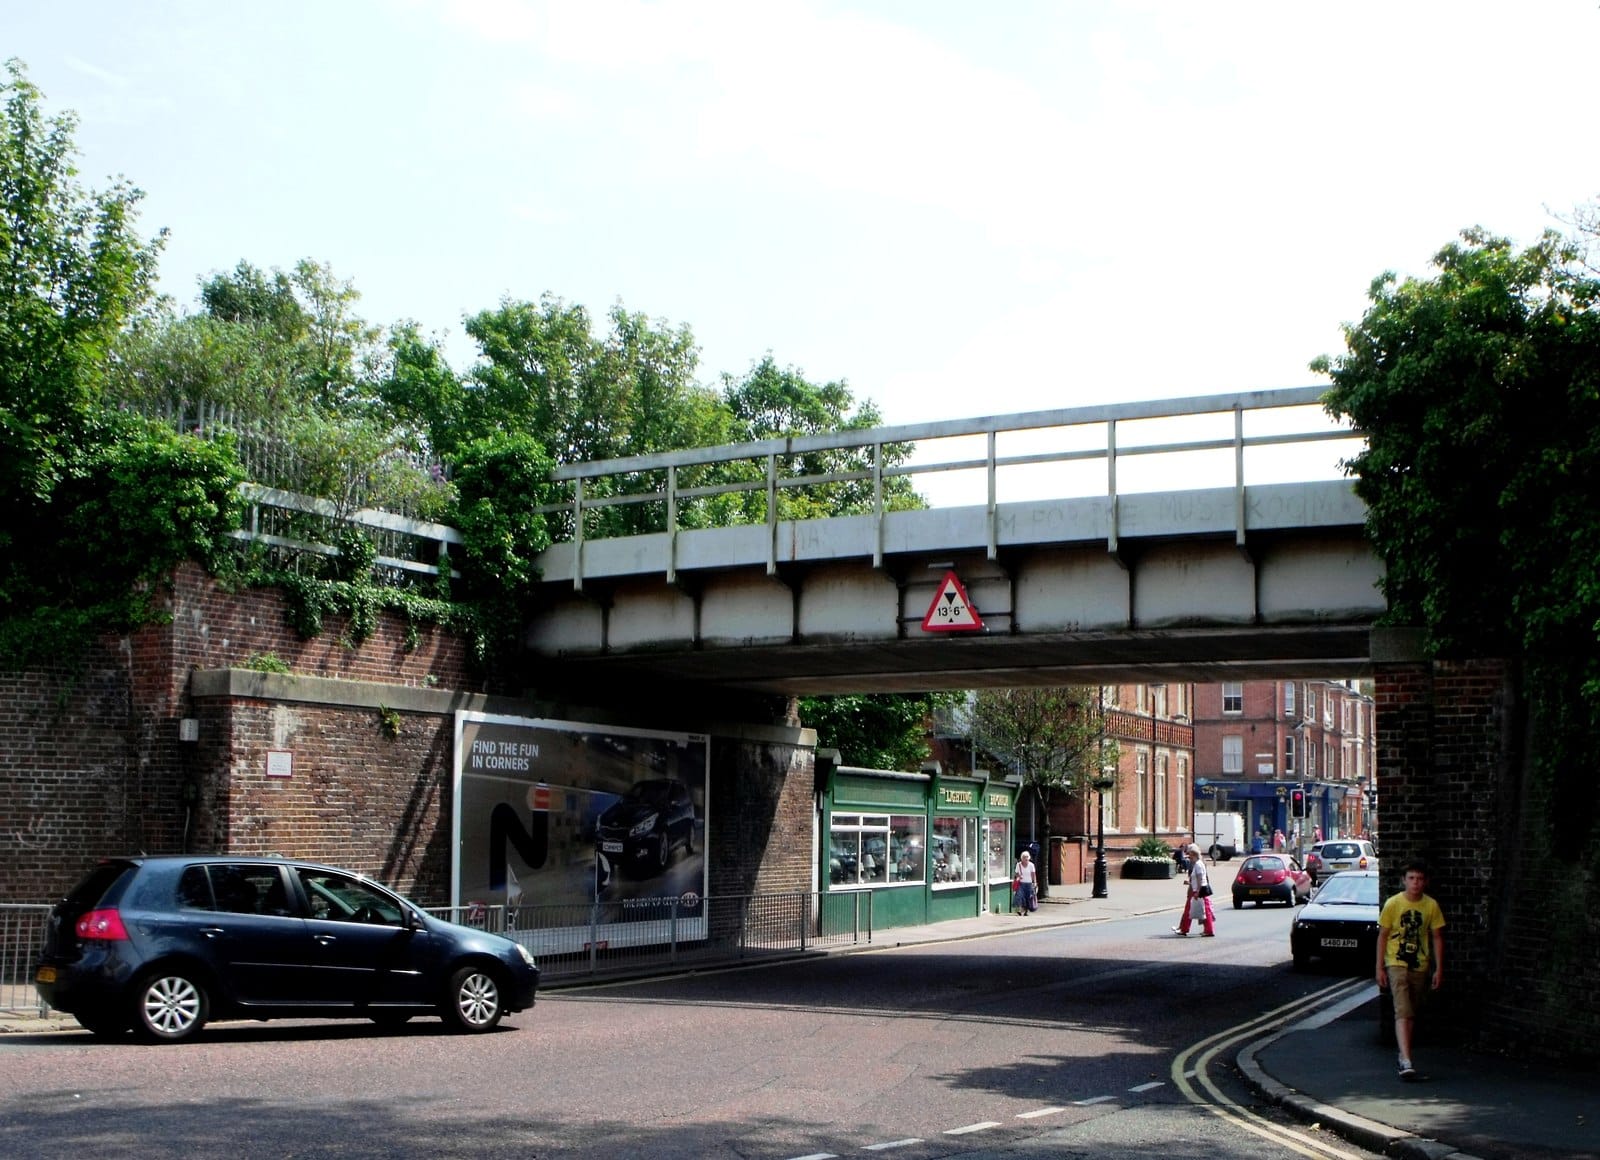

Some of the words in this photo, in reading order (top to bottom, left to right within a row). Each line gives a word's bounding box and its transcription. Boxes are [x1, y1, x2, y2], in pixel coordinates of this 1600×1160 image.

[472, 740, 496, 754] FIND
[498, 742, 517, 756] THE
[519, 743, 539, 757] FUN
[472, 755, 483, 768] IN
[485, 756, 529, 771] CORNERS
